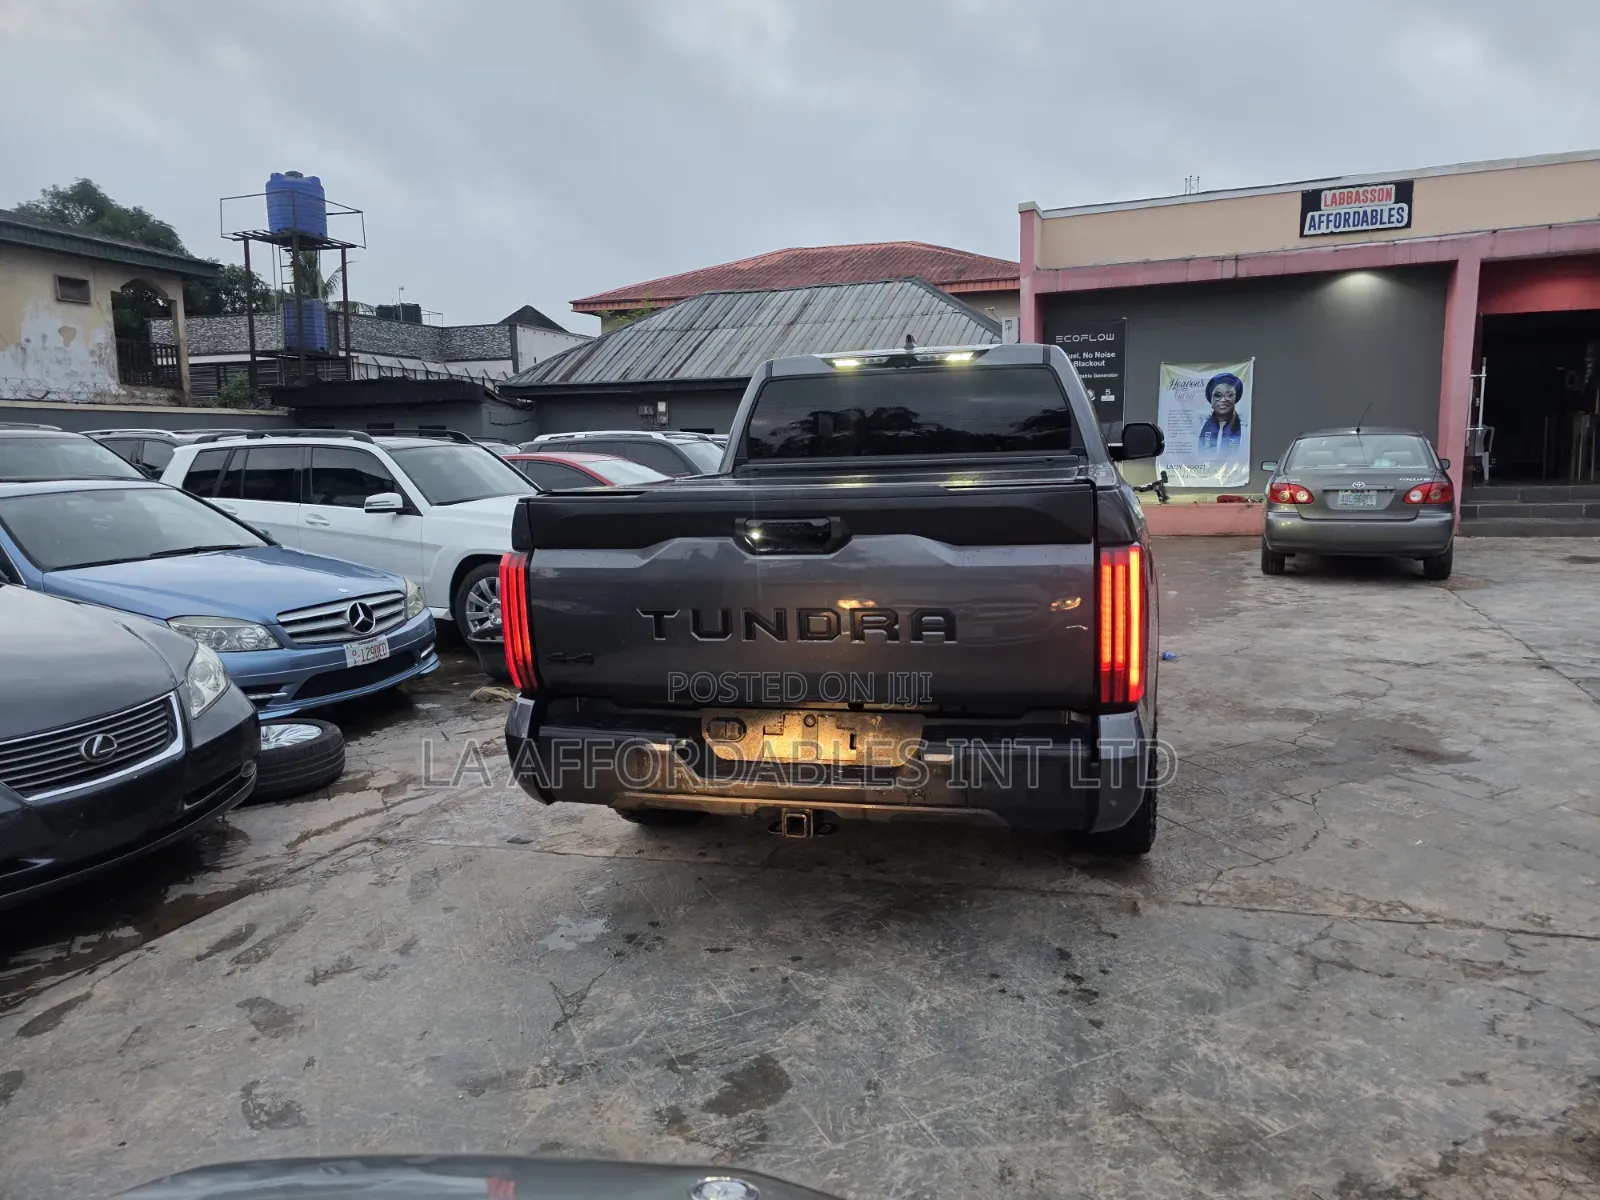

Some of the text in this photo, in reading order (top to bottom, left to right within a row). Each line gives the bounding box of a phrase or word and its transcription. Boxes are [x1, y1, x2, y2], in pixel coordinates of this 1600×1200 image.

[1323, 187, 1393, 207] LABBASSON
[1307, 206, 1405, 232] AFFORDABLES
[1055, 333, 1115, 343] ECOFLOW
[636, 607, 958, 644] TUNDRA
